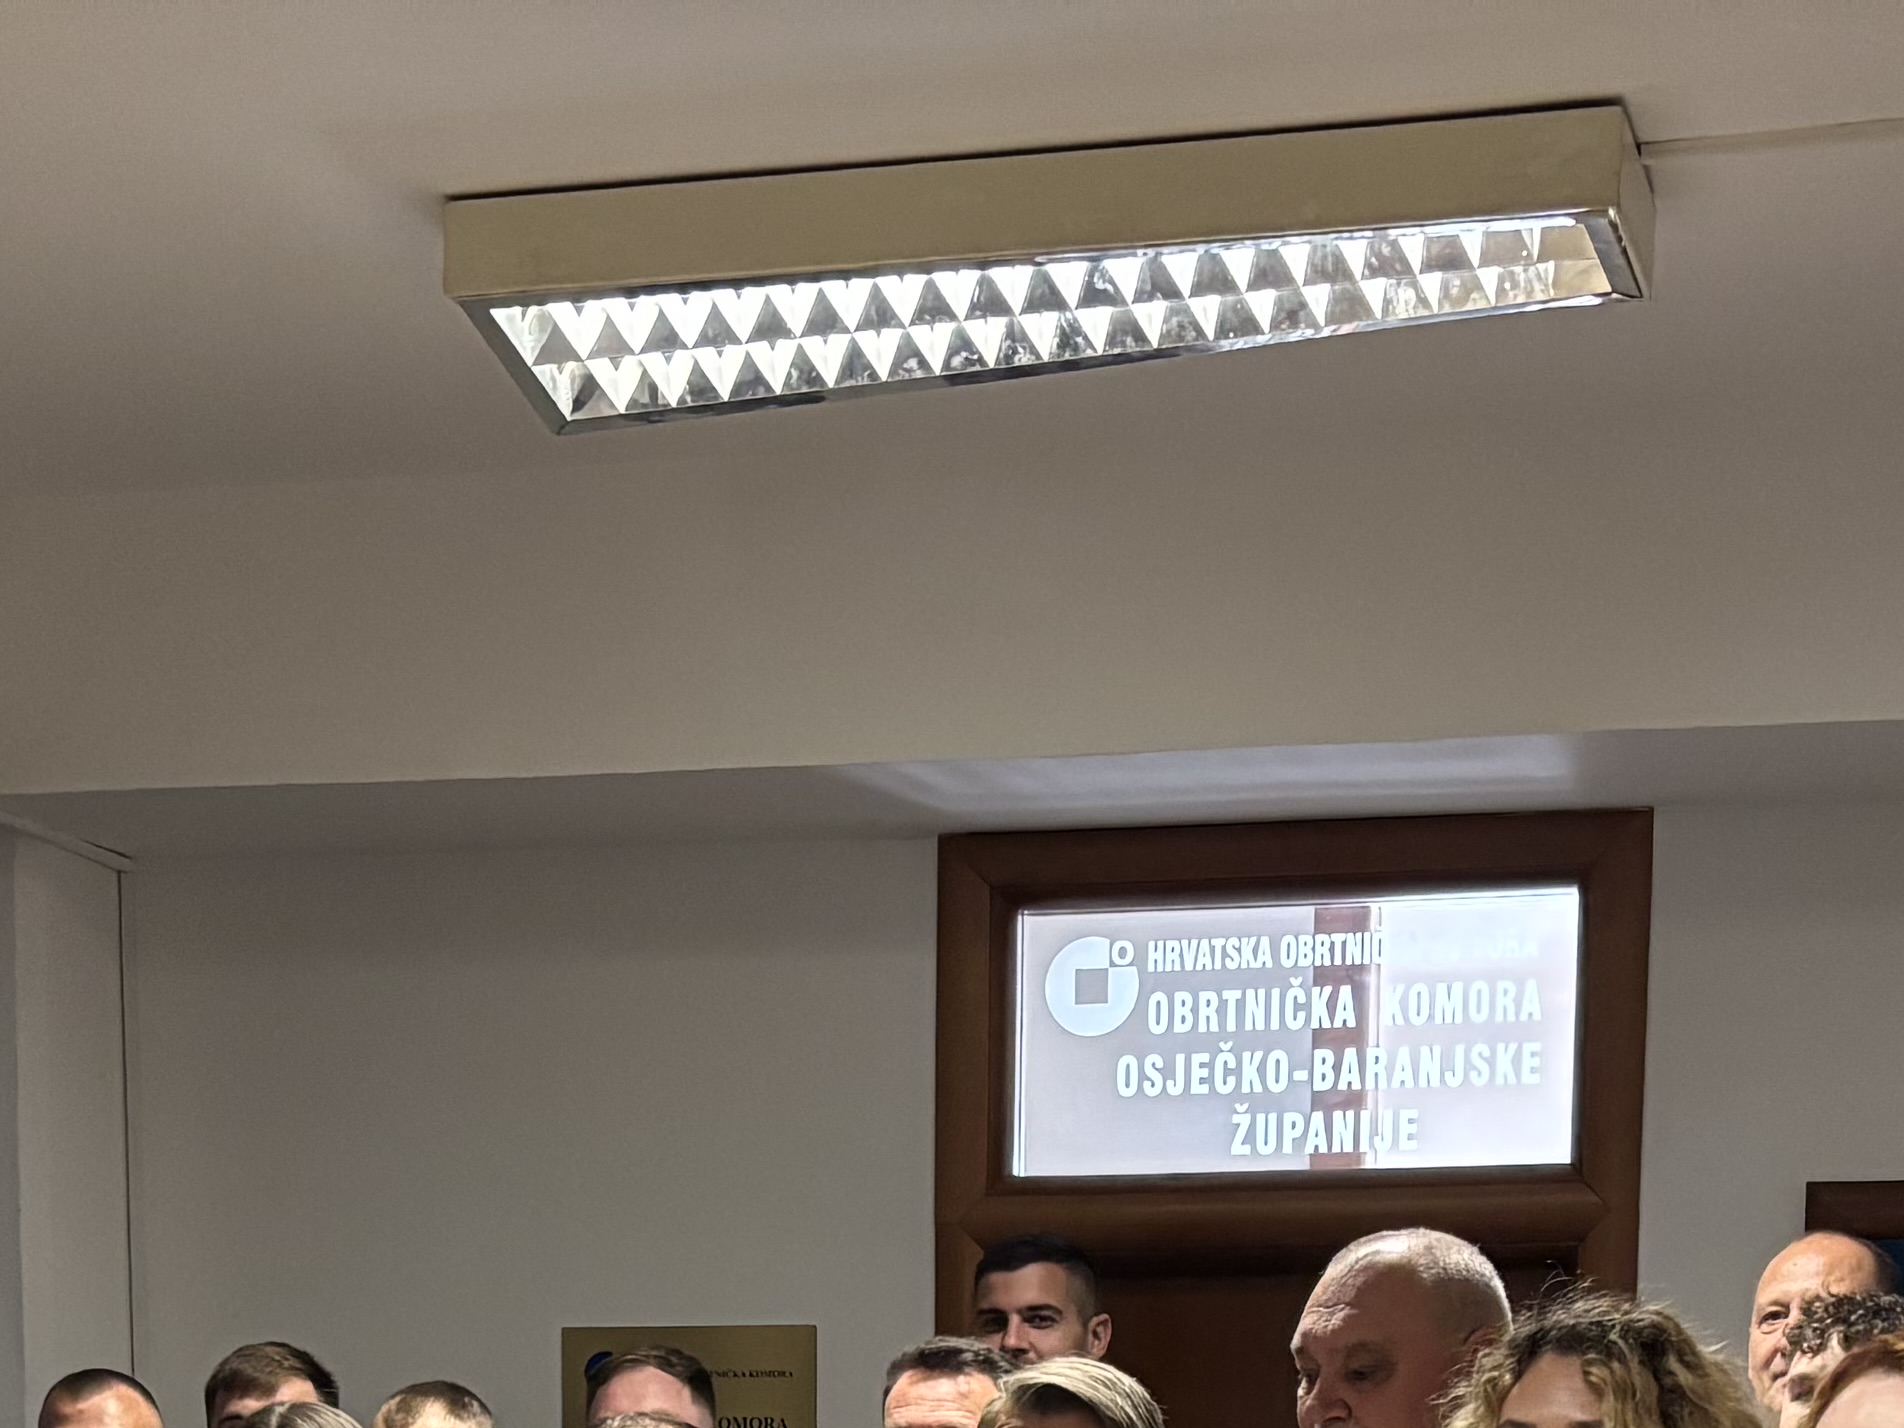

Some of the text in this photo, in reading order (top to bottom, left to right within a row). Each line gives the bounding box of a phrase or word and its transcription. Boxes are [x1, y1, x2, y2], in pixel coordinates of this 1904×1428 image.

[1147, 935, 1274, 973] HRVATSKA
[1147, 976, 1543, 1035] OBRTNIČKA KOMORA
[1116, 1041, 1543, 1098] OSJEČKO-BARANJSKE
[1230, 1103, 1420, 1157] ŽUPANIJE
